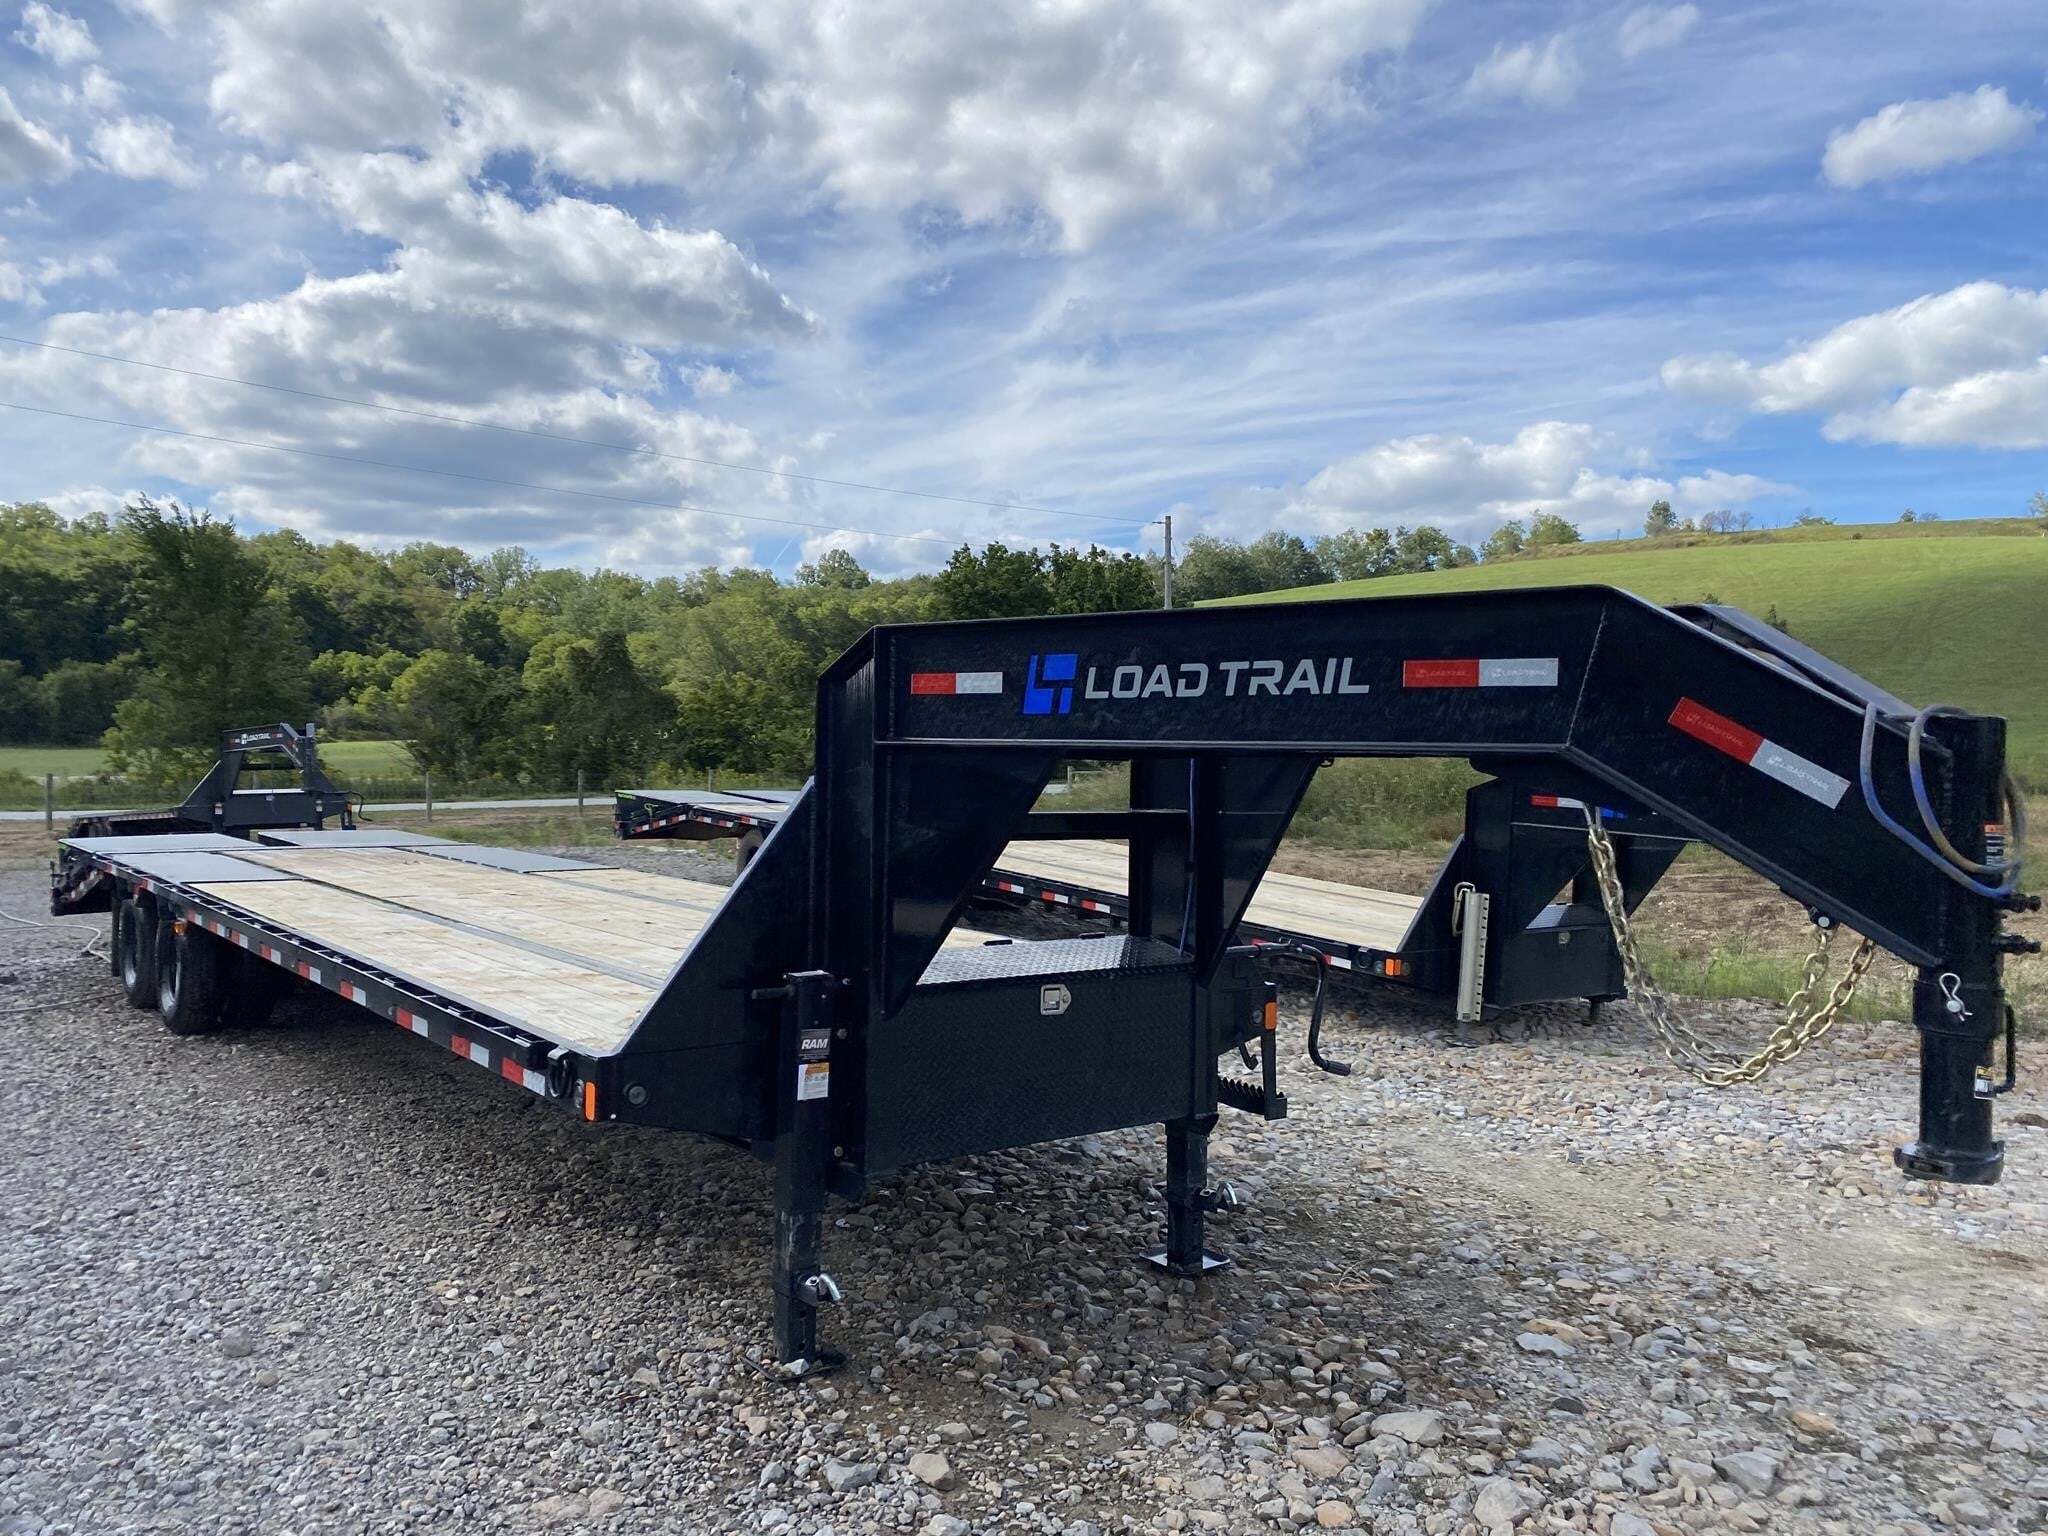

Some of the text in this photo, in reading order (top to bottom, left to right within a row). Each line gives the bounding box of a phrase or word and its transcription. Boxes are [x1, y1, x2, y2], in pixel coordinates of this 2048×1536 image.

[1085, 663, 1209, 699] LOAD
[1219, 657, 1370, 696] TRAIL
[801, 1038, 829, 1050] RAM
